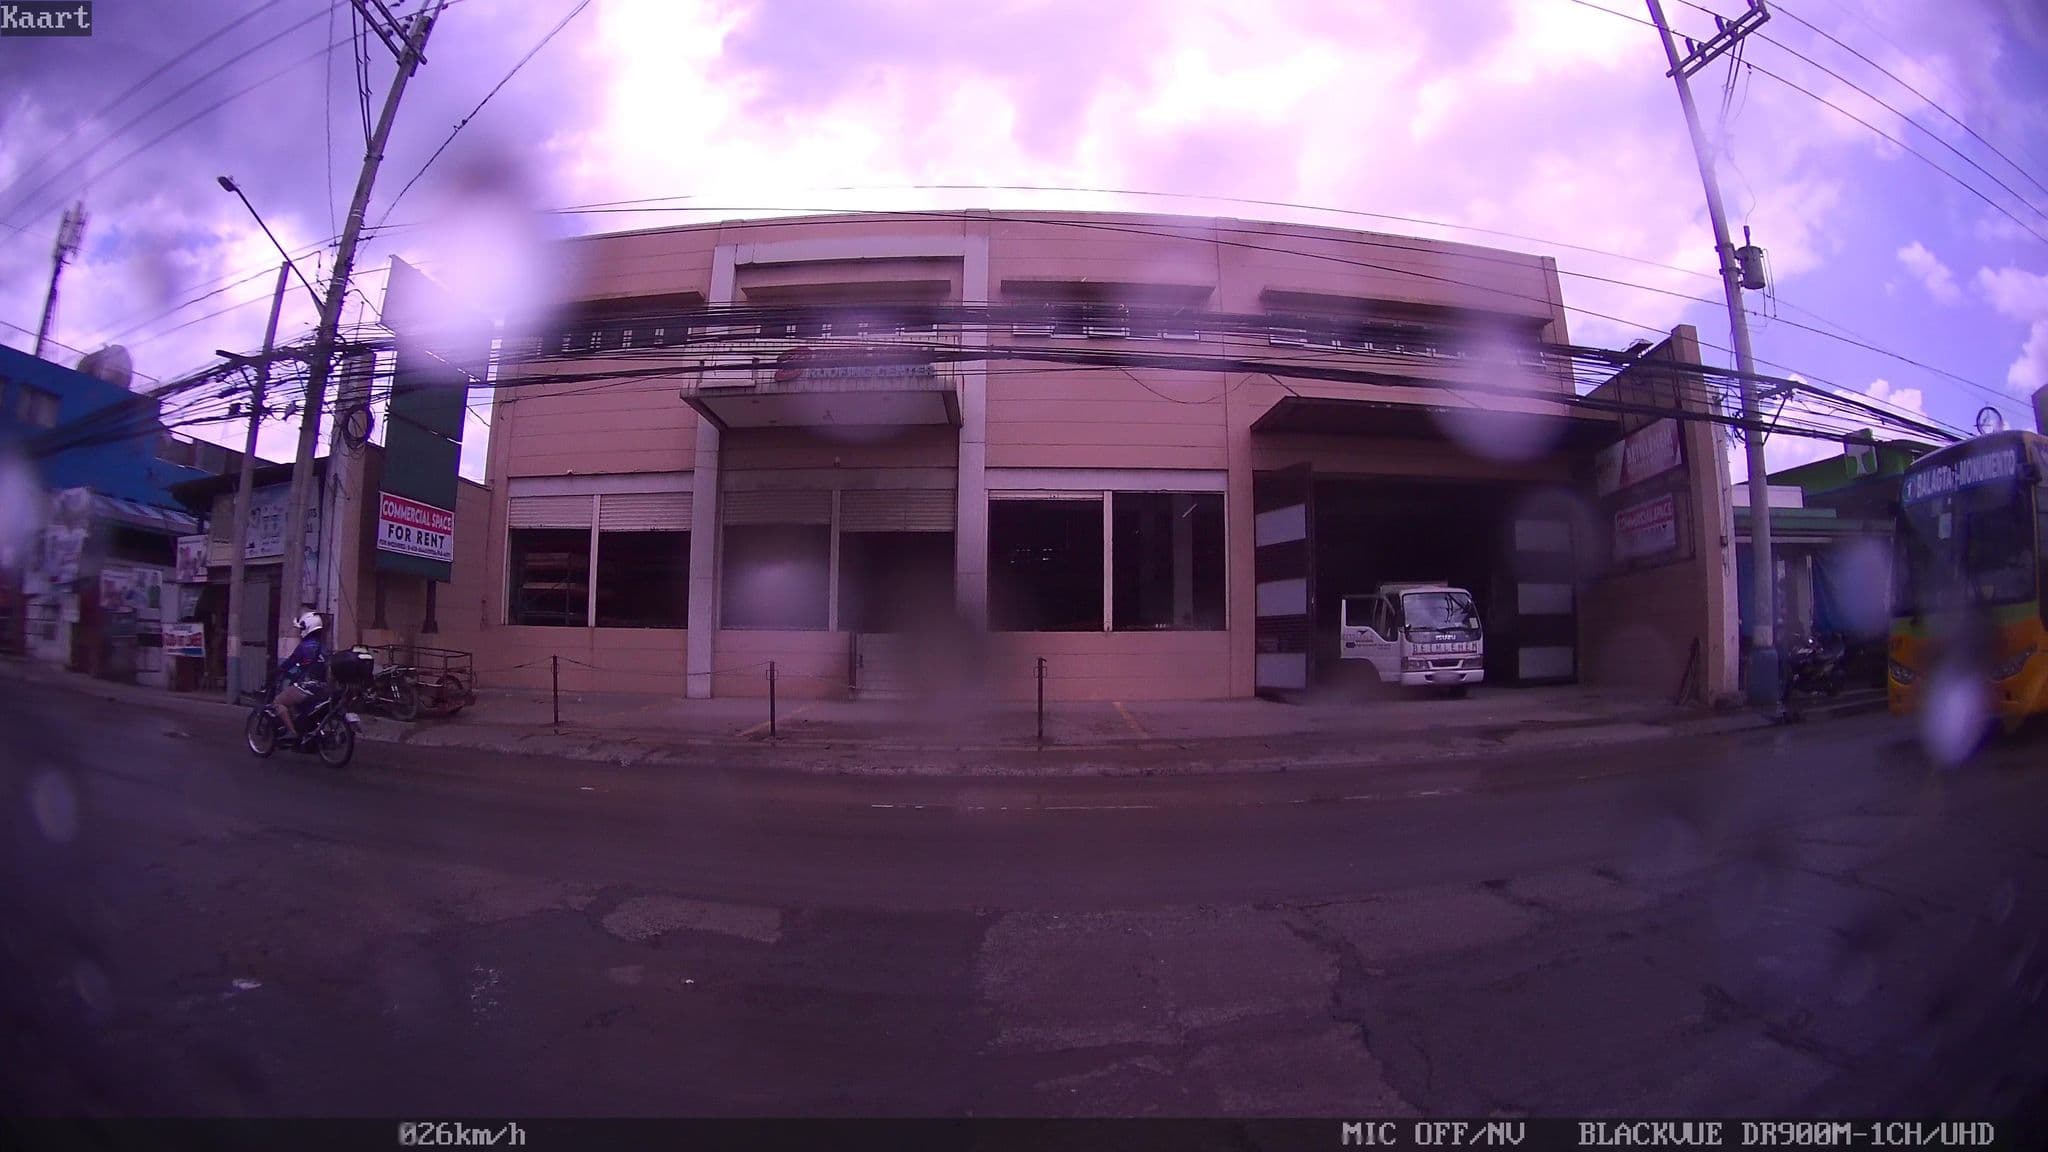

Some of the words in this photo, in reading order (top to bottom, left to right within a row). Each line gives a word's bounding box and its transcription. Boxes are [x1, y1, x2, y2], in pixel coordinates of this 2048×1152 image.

[383, 500, 430, 526] COMMERCIAL
[432, 514, 452, 531] SPACE
[388, 524, 411, 542] FOR
[416, 531, 445, 549] RENT
